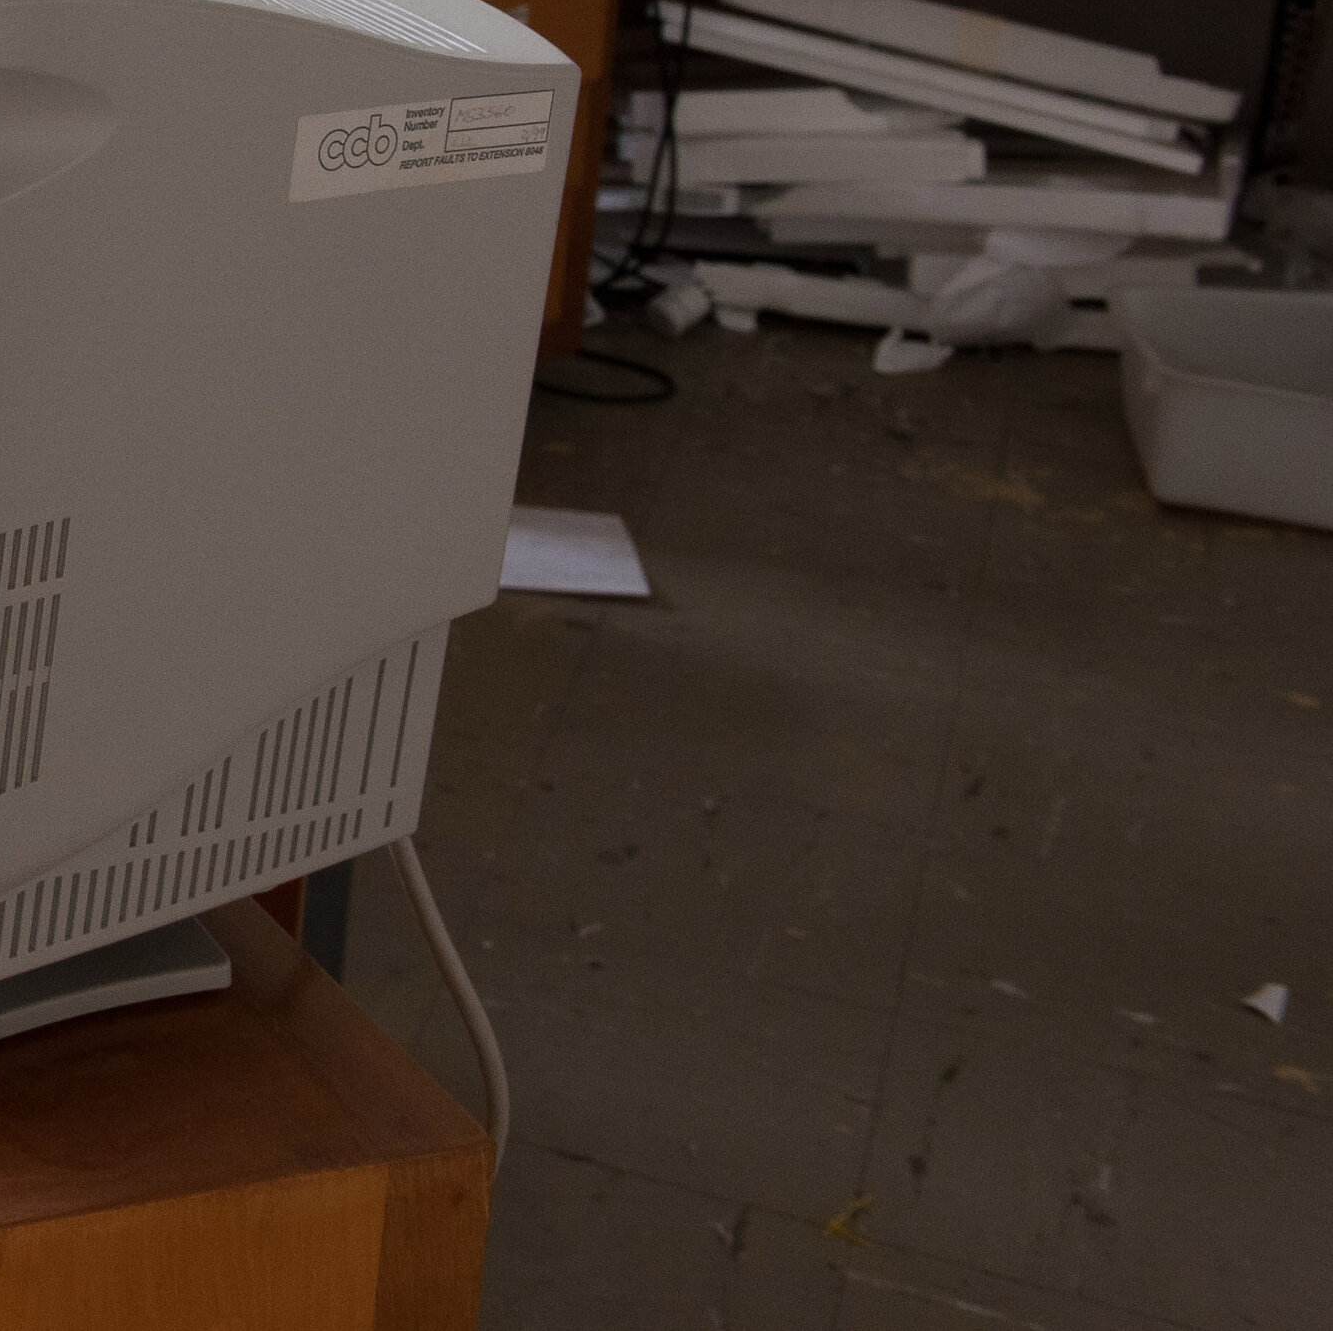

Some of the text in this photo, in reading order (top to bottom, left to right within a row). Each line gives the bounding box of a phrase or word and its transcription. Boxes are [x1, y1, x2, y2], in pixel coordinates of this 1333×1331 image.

[406, 107, 445, 118] Inventory
[404, 119, 439, 132] Number
[318, 114, 398, 172] ccb
[402, 139, 425, 152] Dept.
[399, 157, 435, 170] REPORT
[433, 153, 466, 166] FAULTS
[467, 152, 479, 163] TO
[478, 147, 525, 161] EXTENSION
